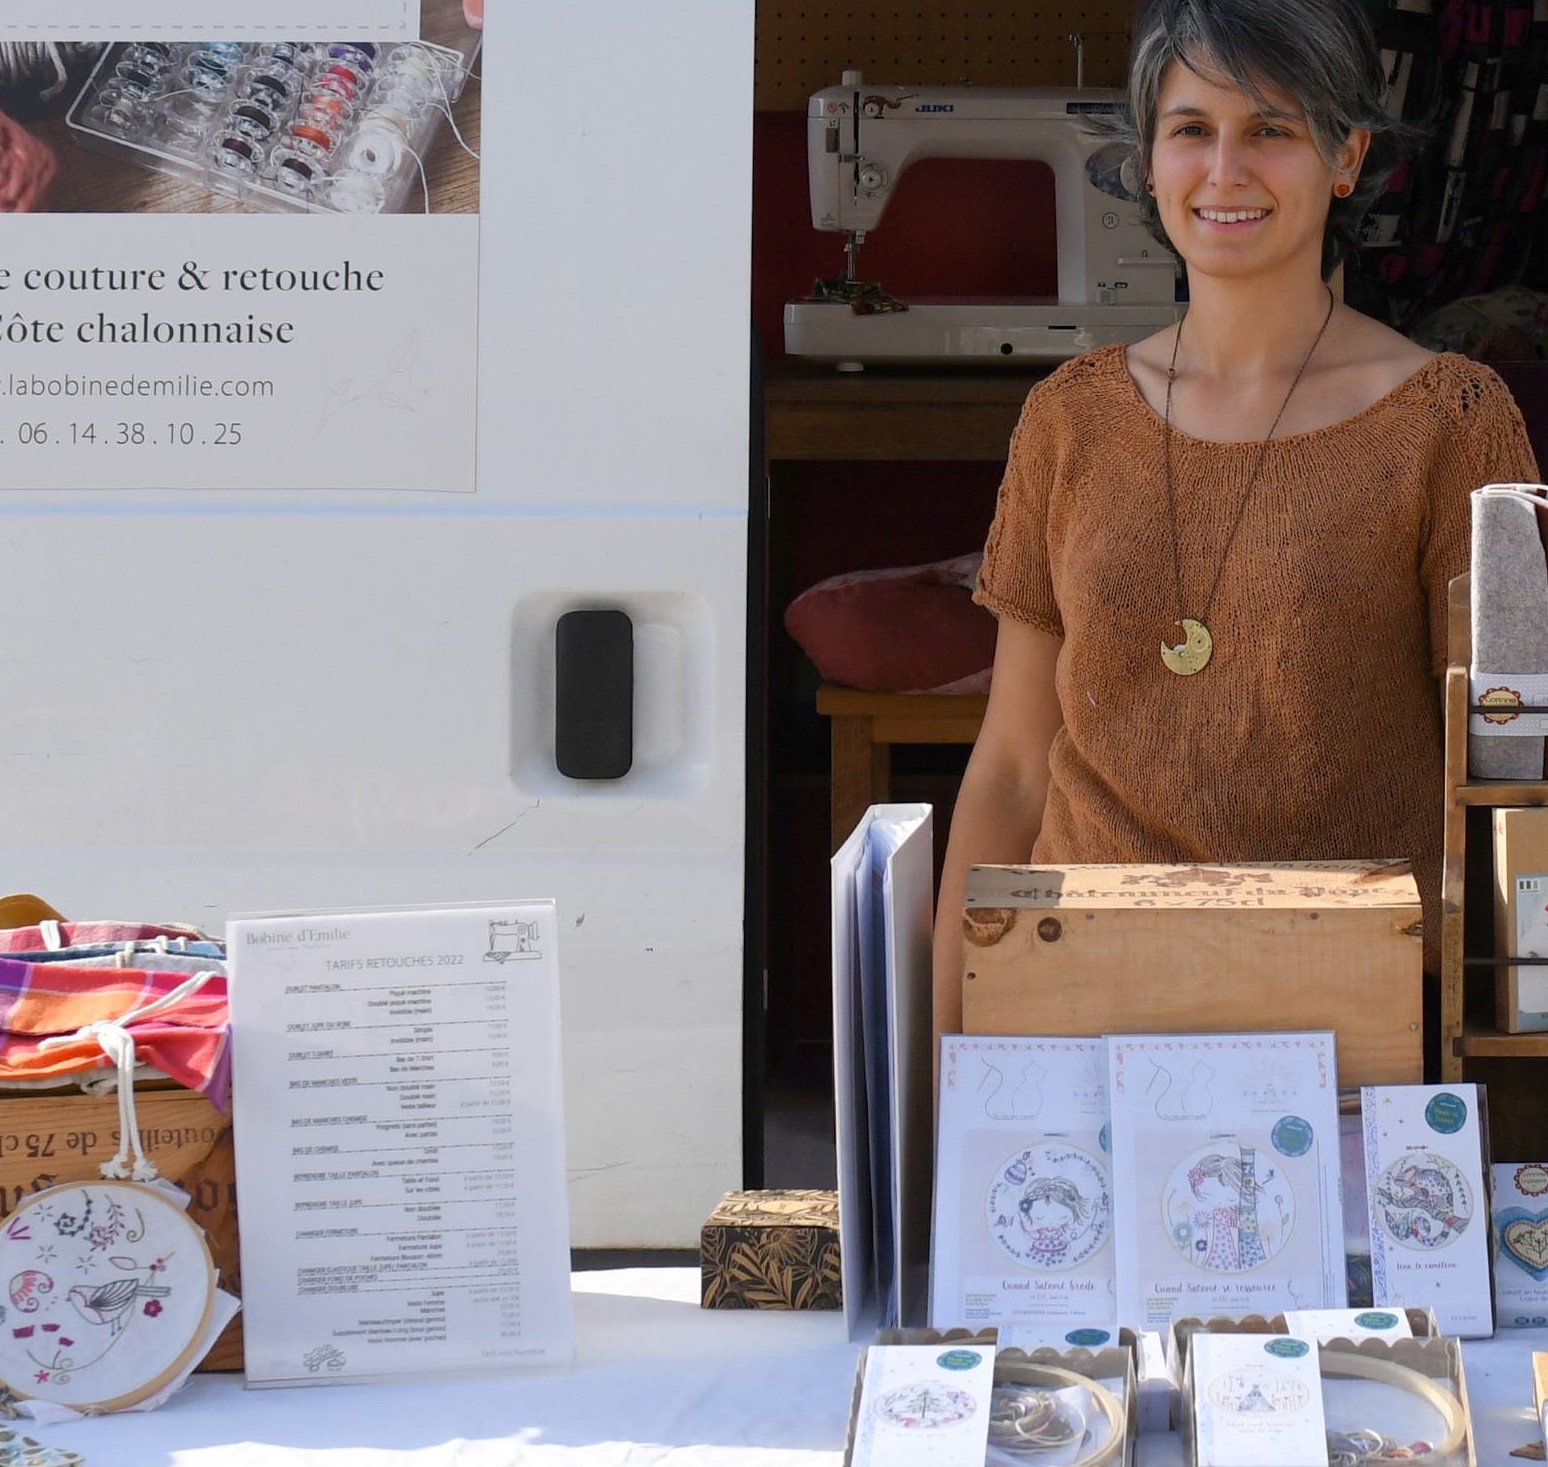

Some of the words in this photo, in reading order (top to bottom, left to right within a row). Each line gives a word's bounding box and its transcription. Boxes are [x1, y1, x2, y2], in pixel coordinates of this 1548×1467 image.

[915, 104, 954, 113] JUKI
[23, 265, 166, 291] couture
[177, 260, 211, 291] &
[221, 261, 385, 292] retouche
[76, 312, 295, 344] chalonnaise
[246, 930, 293, 945] Bobine
[325, 959, 363, 972] TARIFS
[366, 956, 434, 970] RETOUCHES
[437, 954, 465, 967] 2022
[65, 1132, 98, 1157] de
